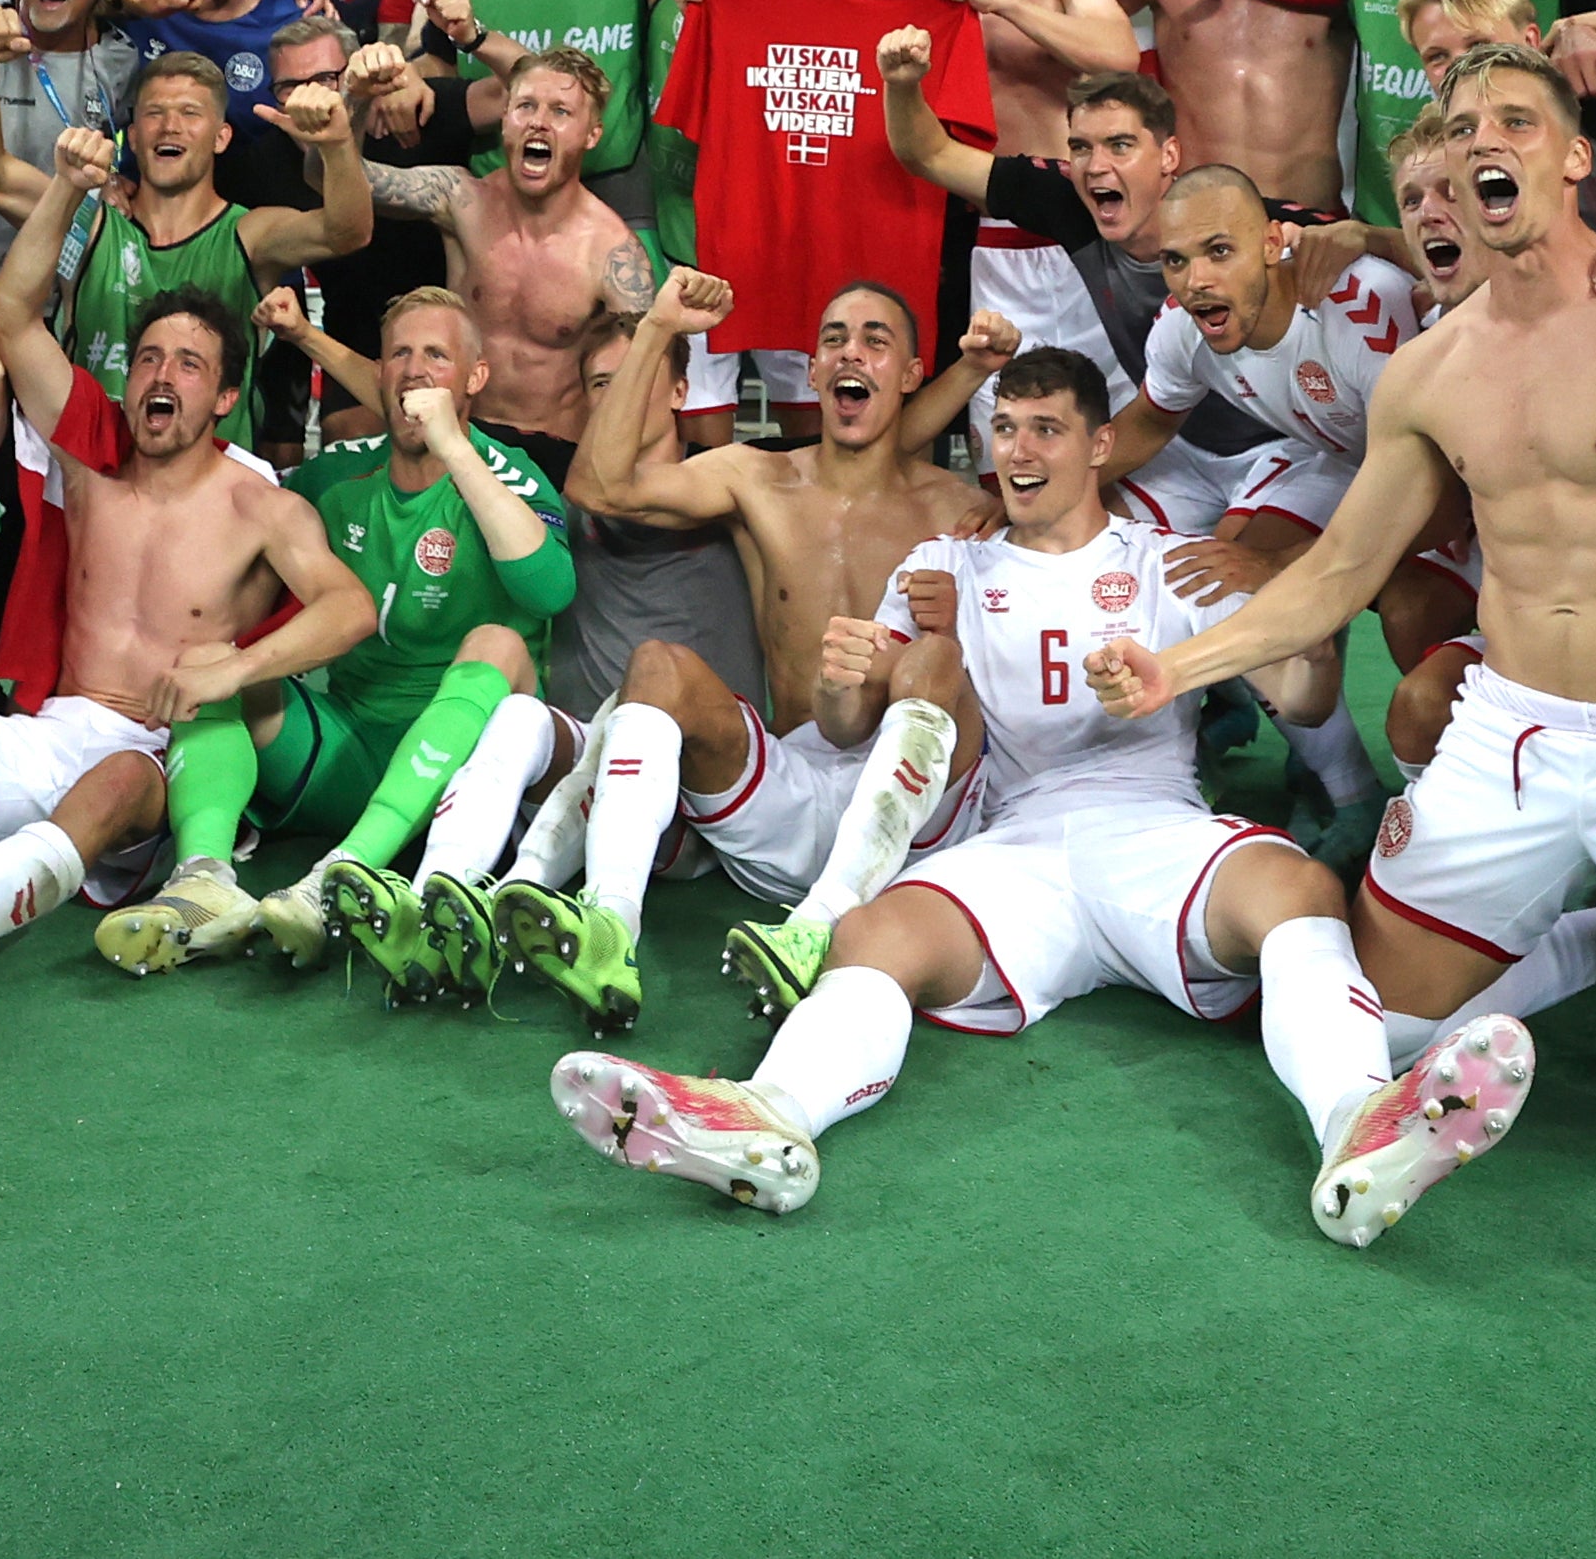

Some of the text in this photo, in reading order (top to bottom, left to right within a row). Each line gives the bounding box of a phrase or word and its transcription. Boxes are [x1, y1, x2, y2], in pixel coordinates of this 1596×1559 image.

[563, 23, 634, 55] GAME
[771, 47, 854, 69] VI SKAL
[747, 67, 877, 95] IKKE HJEM...
[1361, 50, 1437, 100] #EQUA
[770, 91, 851, 113] VI SKAL
[764, 111, 854, 137] VIDERE!
[426, 543, 450, 559] DBU
[1101, 583, 1130, 597] DBU
[378, 581, 398, 646] 1
[1040, 629, 1069, 705] 6
